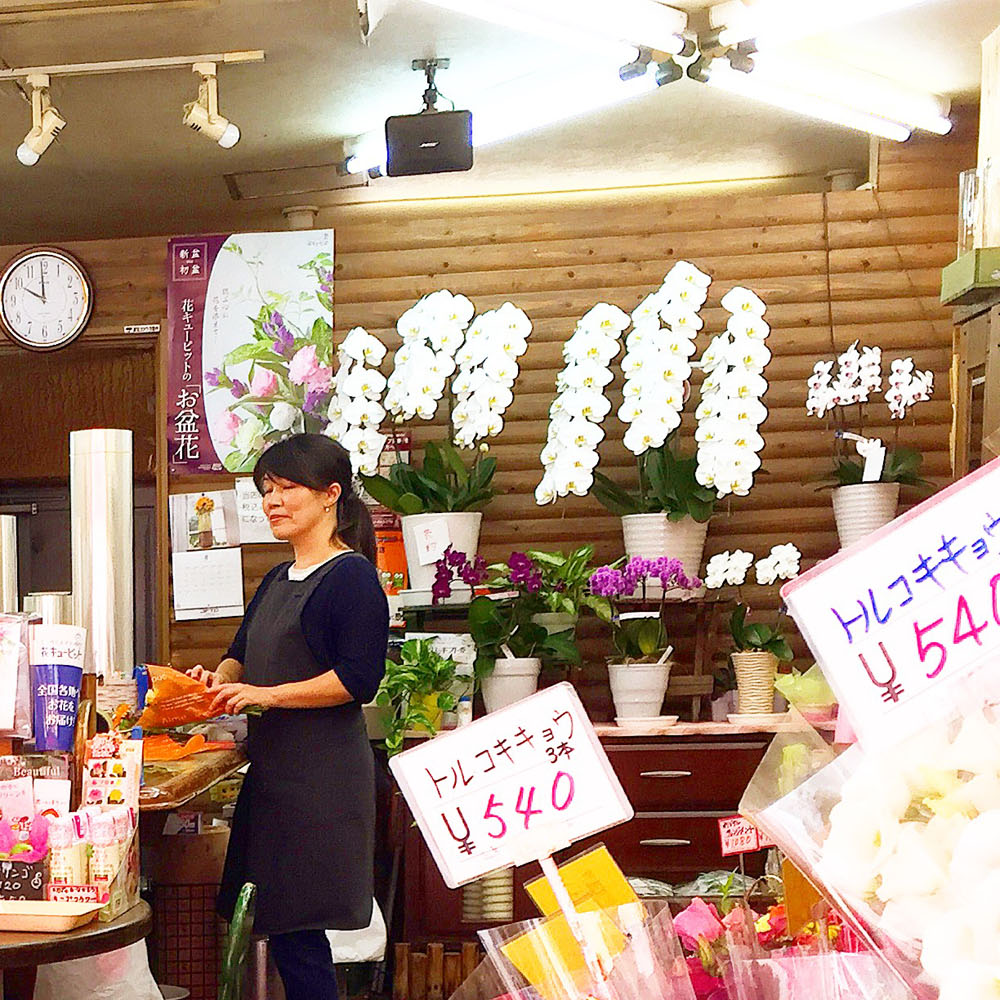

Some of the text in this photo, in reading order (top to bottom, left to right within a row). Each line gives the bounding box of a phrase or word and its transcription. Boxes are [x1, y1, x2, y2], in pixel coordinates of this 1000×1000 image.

[13, 766, 61, 777] Beautiful
[425, 710, 575, 799] トルコキキョウ
[545, 741, 576, 764] 3本
[441, 770, 576, 856] ¥540
